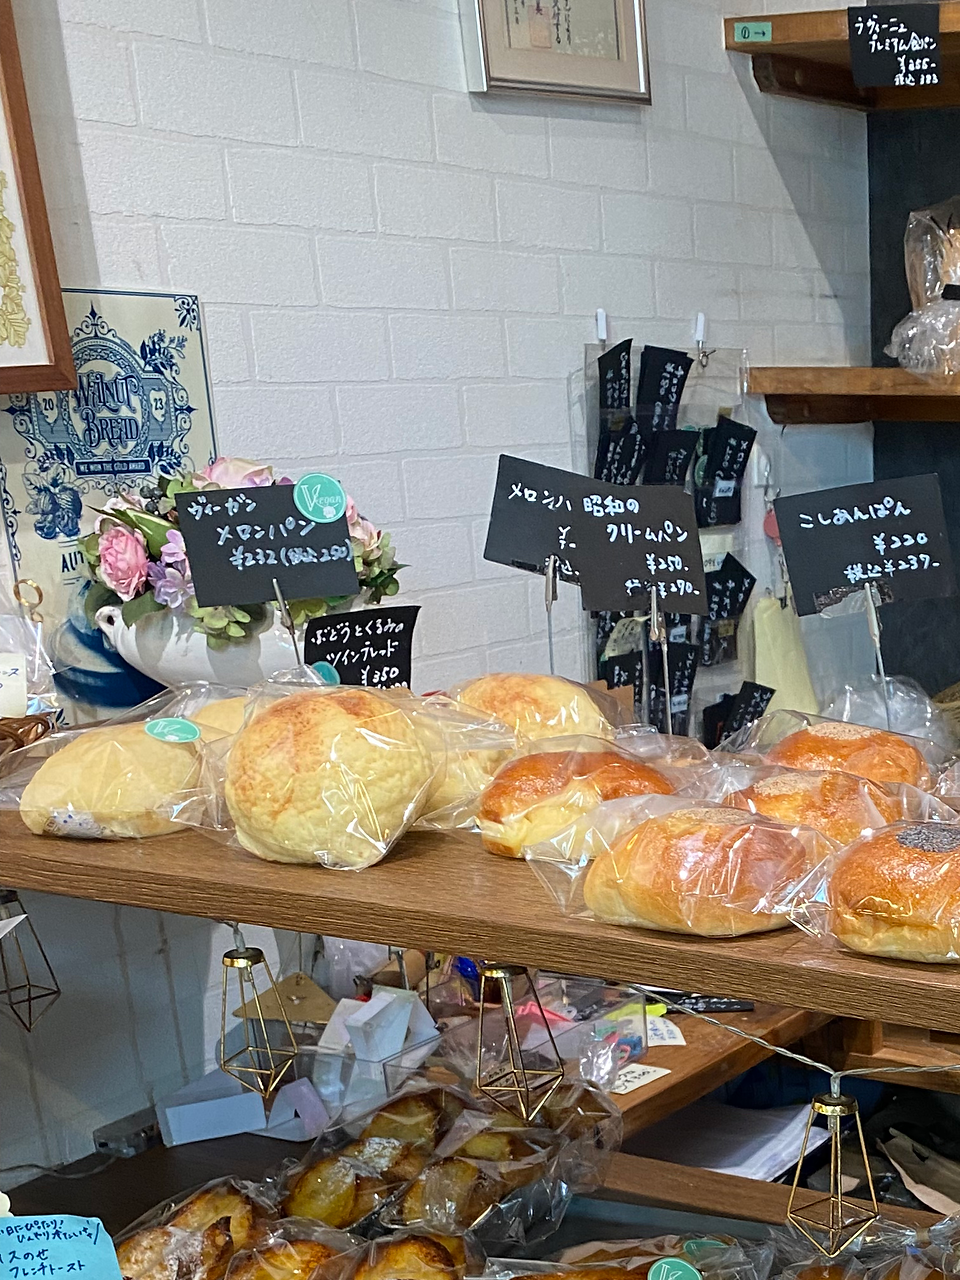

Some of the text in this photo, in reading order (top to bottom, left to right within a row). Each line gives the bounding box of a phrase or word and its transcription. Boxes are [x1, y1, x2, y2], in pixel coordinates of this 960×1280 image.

[186, 492, 257, 521] ヴィーガン
[582, 494, 640, 517] 昭和の
[799, 496, 912, 529] こしあんぱん
[215, 515, 316, 546] メロンパン
[605, 519, 688, 544] クリームパン
[872, 532, 928, 556] ¥220
[8, 1260, 86, 1279] フレンチトースト
